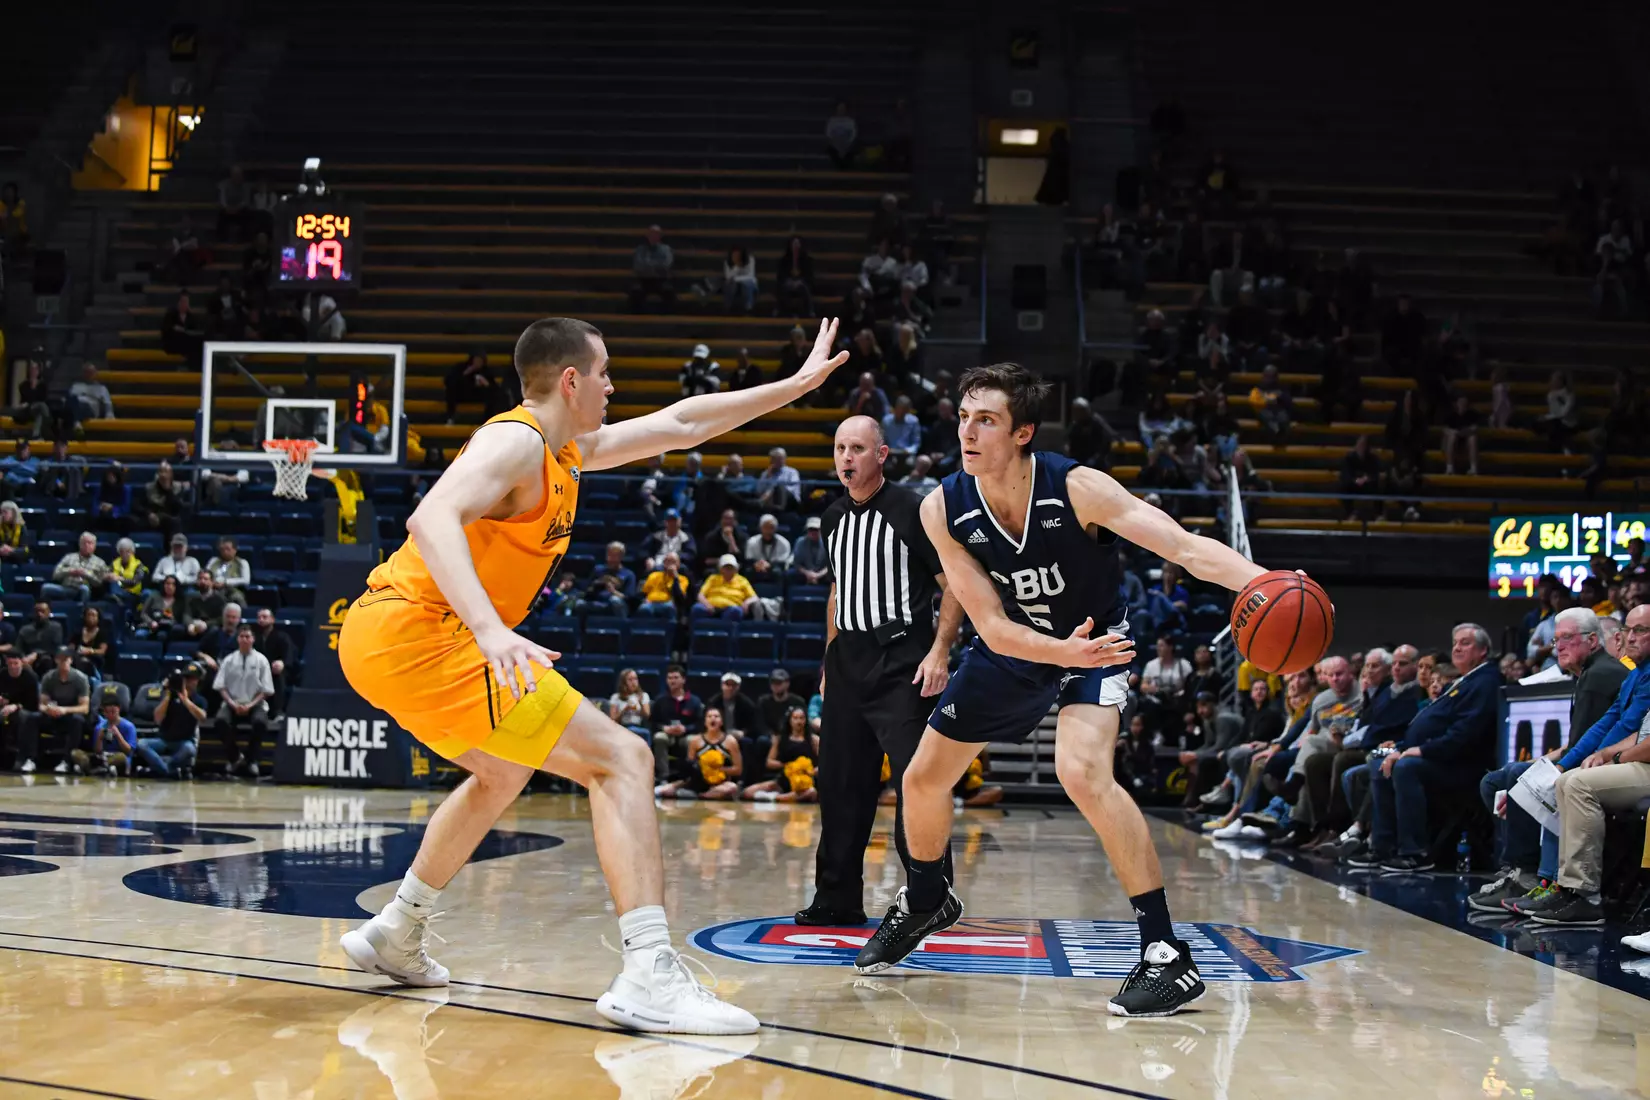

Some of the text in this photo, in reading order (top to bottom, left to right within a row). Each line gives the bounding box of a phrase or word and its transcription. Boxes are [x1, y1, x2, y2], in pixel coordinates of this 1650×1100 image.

[296, 214, 350, 239] 12:54
[308, 240, 342, 279] 19
[1041, 517, 1062, 529] WAC
[967, 535, 989, 544] adidas
[1493, 518, 1569, 557] Cal 56
[1584, 529, 1599, 553] 2
[1497, 575, 1511, 598] 3
[1523, 575, 1534, 598] 1
[286, 716, 389, 749] MUSCLE
[303, 747, 368, 778] MILK
